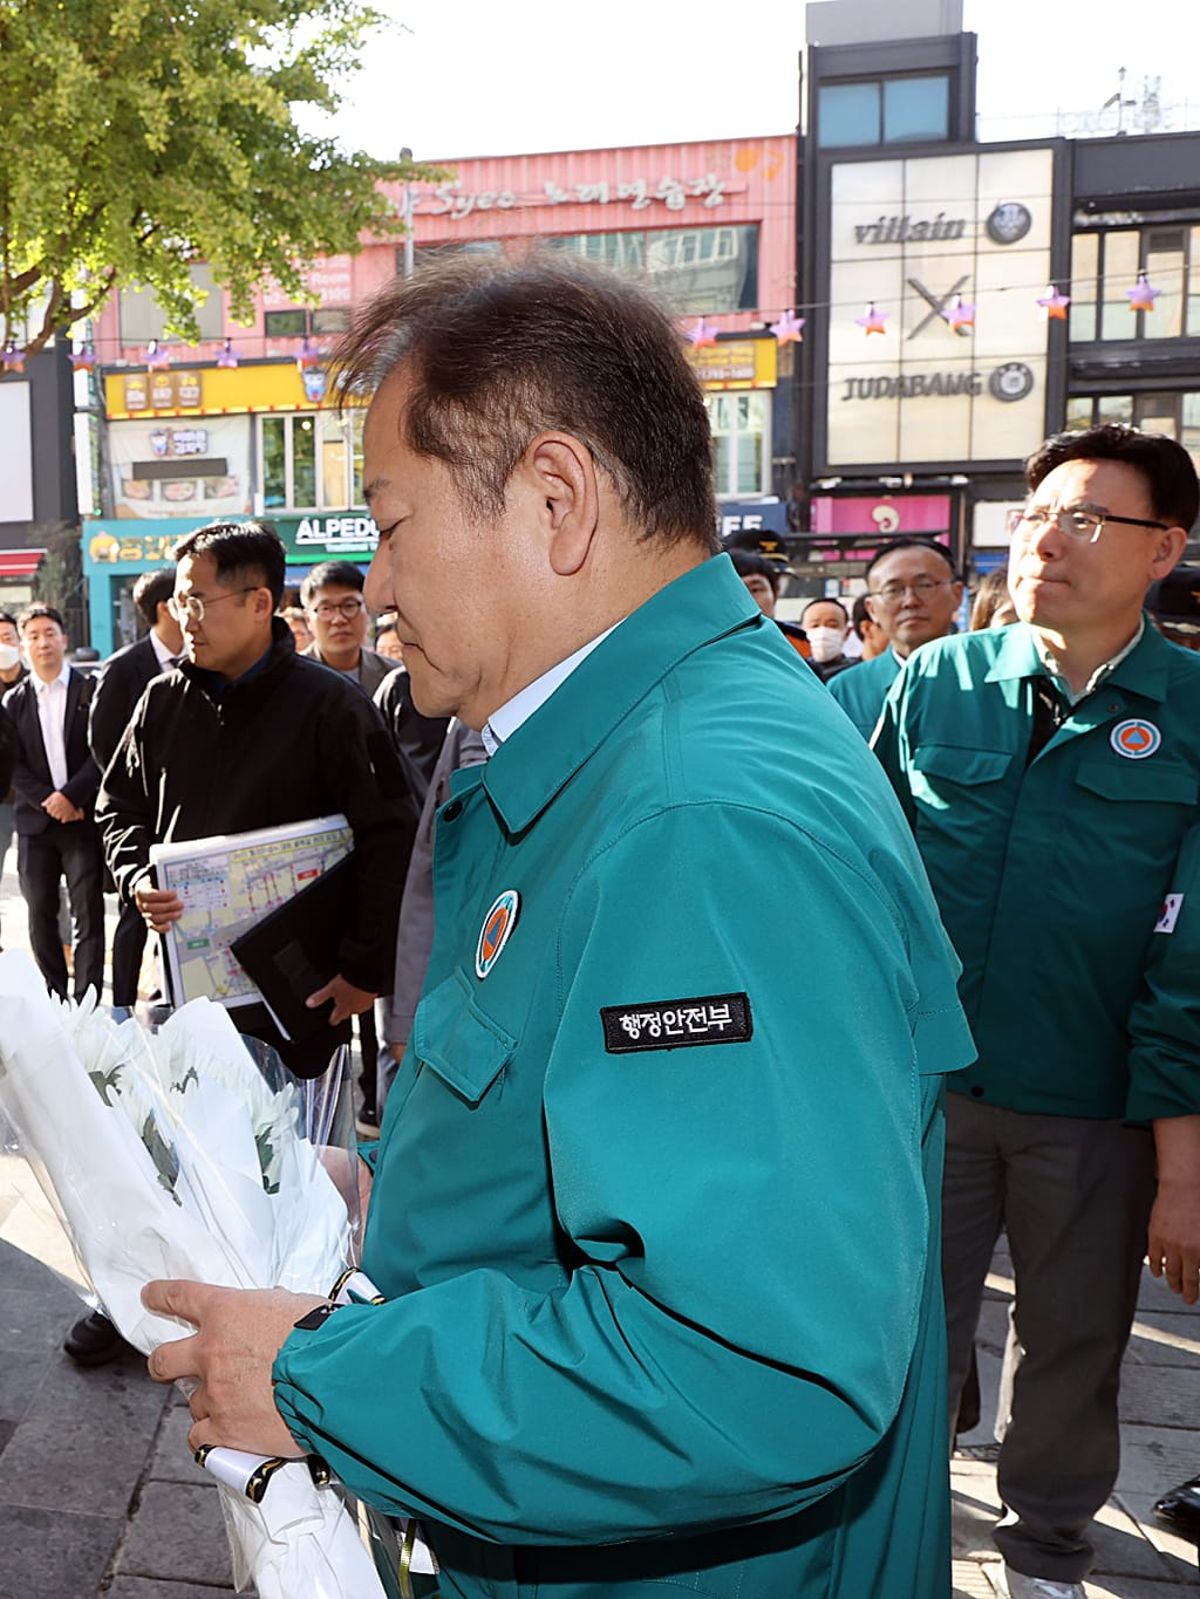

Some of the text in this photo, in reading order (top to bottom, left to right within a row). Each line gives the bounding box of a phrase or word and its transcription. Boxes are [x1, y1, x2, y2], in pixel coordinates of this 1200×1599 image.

[853, 212, 966, 245] villain
[841, 372, 982, 401] JUDABANG
[619, 1004, 733, 1039] 행정안전부
